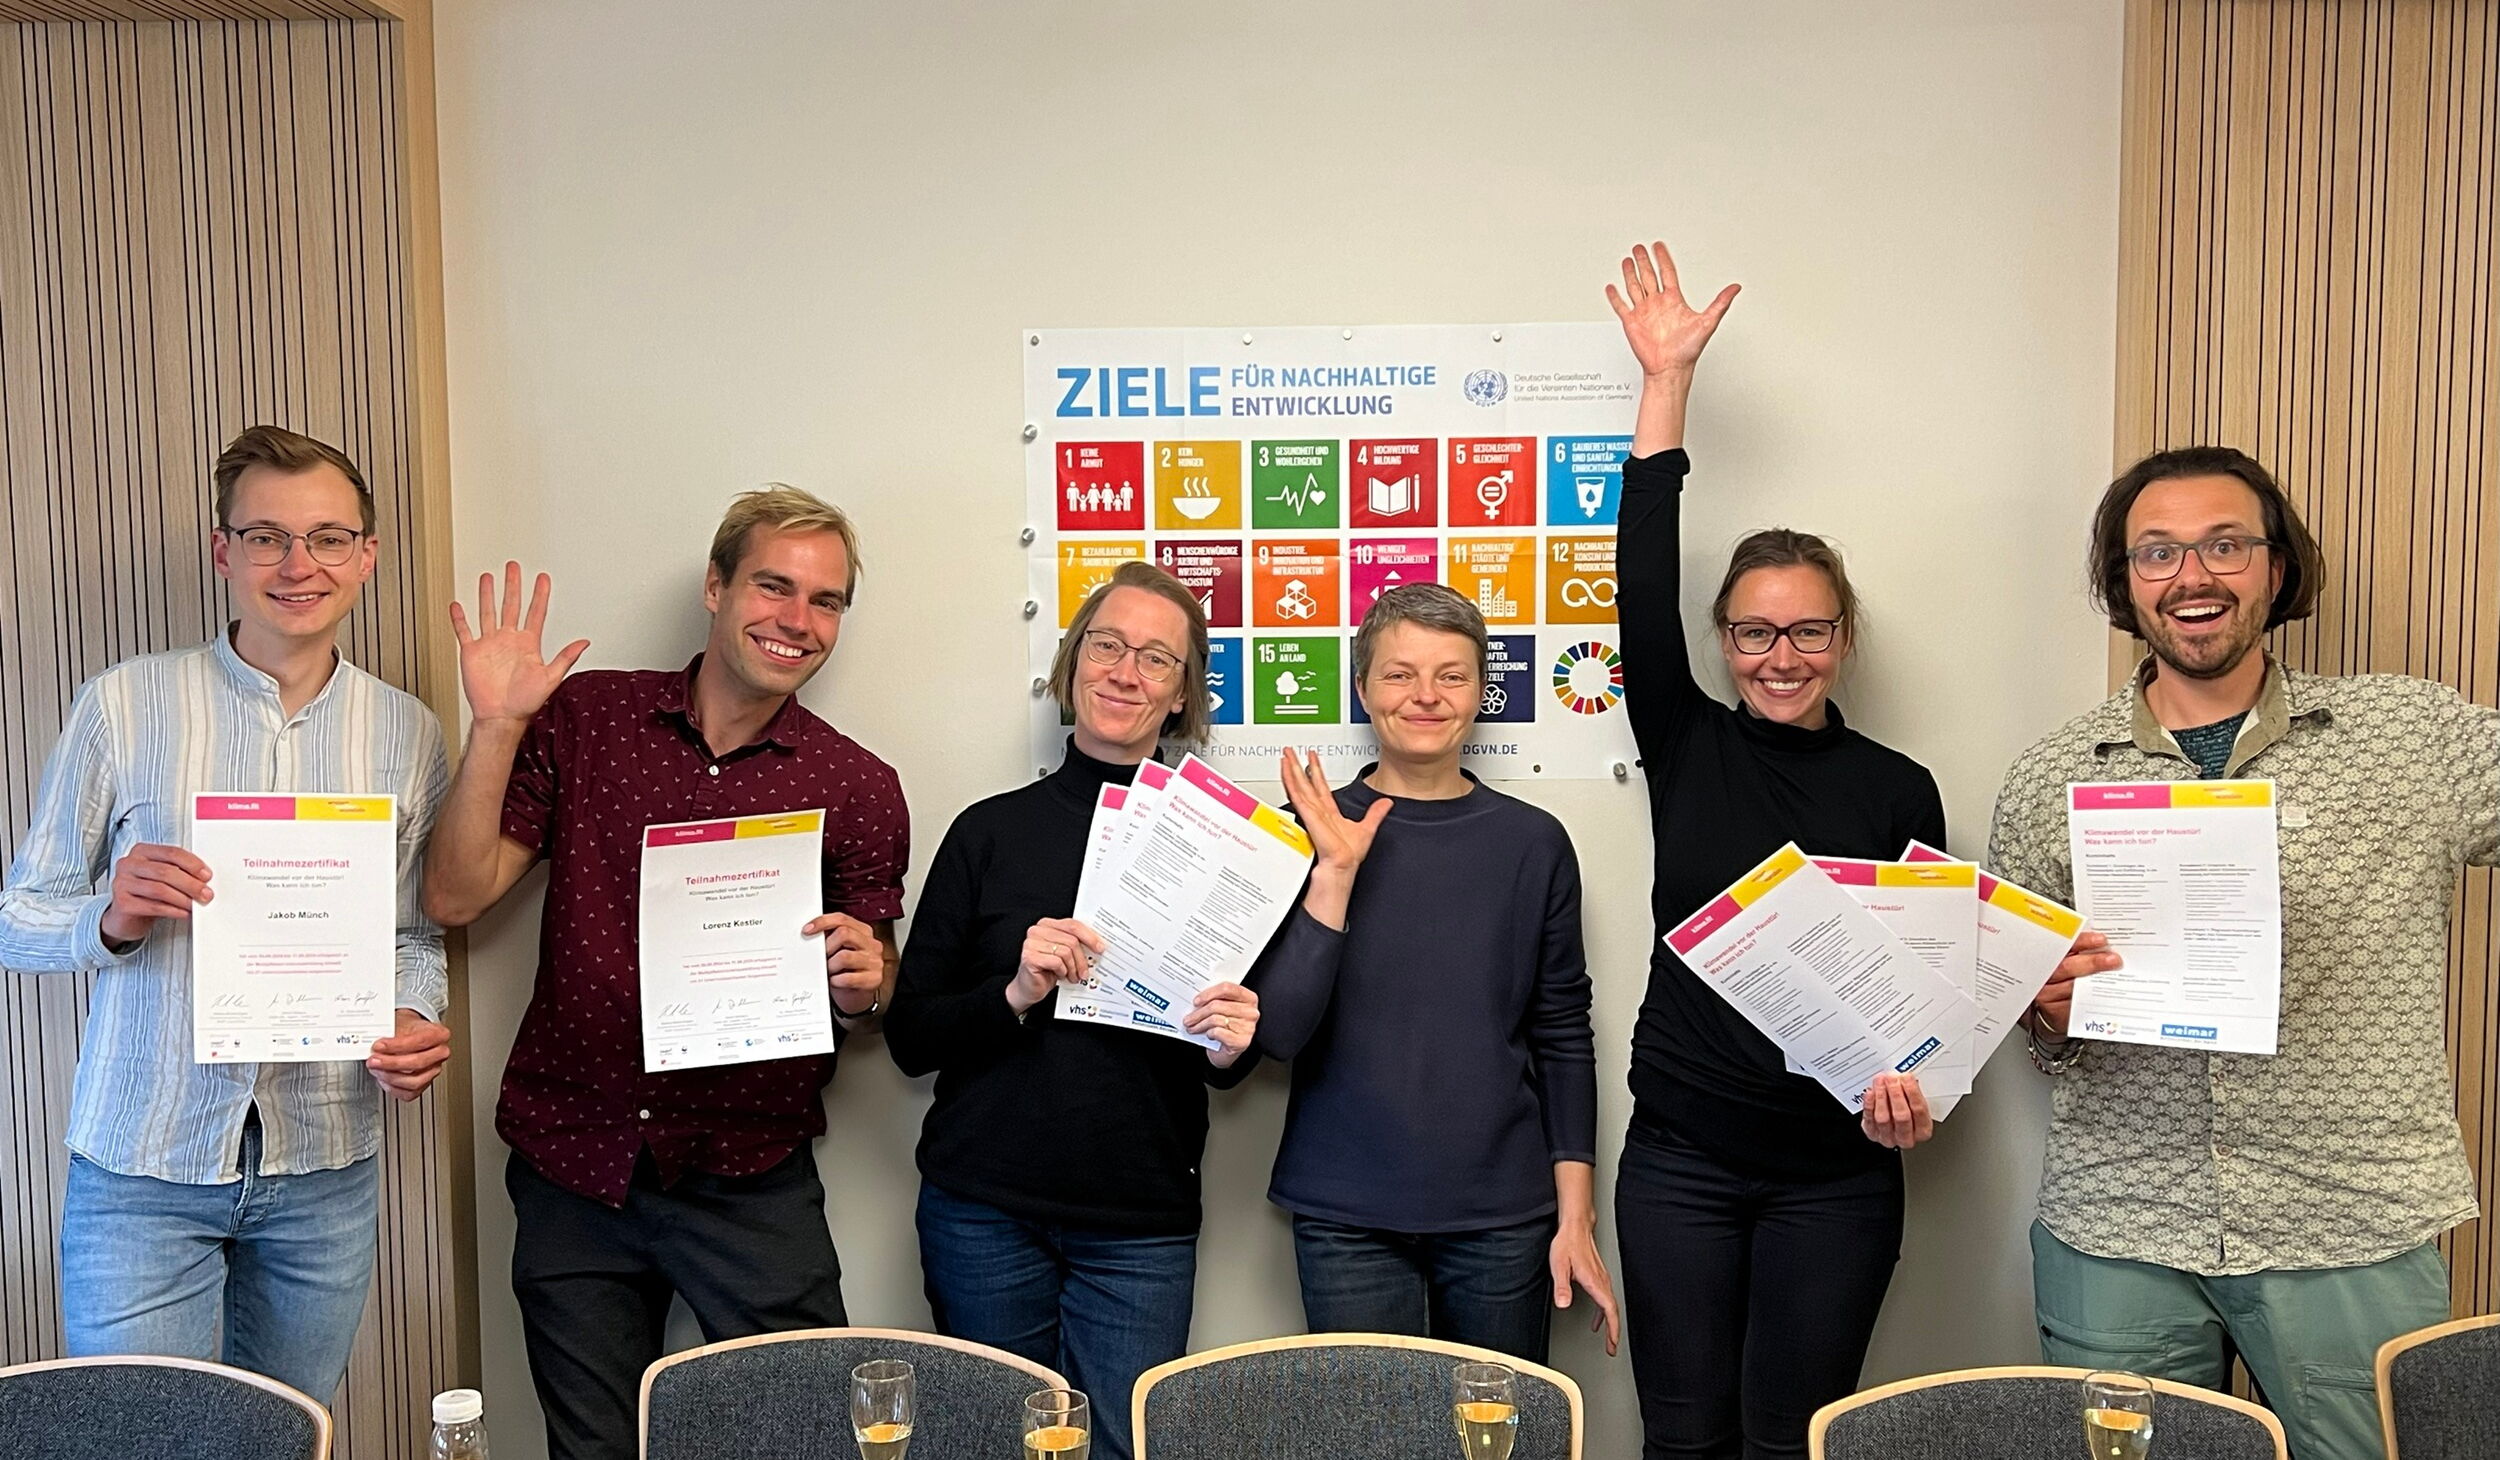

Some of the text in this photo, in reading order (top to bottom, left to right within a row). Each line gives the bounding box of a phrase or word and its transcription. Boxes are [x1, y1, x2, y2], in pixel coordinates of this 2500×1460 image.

[1232, 364, 1437, 387] FÜR NACHHALTIGE
[1514, 373, 1602, 382] Deutsche Gesellschaft
[1056, 367, 1221, 417] ZIELE
[1514, 384, 1526, 392] für
[1527, 384, 1539, 392] die
[1541, 384, 1578, 392] Vereinten
[1579, 383, 1614, 392] Nationen
[1232, 395, 1393, 416] ENTWICKLUNG
[1178, 448, 1193, 456] KEIN
[1275, 446, 1329, 456] GESUNDHEIT UND
[1374, 445, 1420, 454] HOCHWERTIGE
[1473, 444, 1525, 453] GESCHLECHTER-
[1572, 442, 1606, 452] SAUBERES
[1080, 448, 1099, 457] KEINE
[1259, 447, 1269, 467] 3
[1357, 446, 1368, 465] 4
[1456, 444, 1466, 464] 5
[1555, 443, 1566, 463] 6
[1572, 453, 1586, 462] UND
[1065, 448, 1073, 468] 1
[1080, 458, 1103, 468] ARMUT
[1161, 448, 1171, 468] 2
[1178, 458, 1204, 467] HUNGER
[1275, 457, 1323, 466] WOHLERGEHEN
[1374, 456, 1402, 465] BILDUNG
[1473, 454, 1509, 464] GLEICHHEIT
[1124, 547, 1137, 556] UND
[1377, 544, 1406, 554] WENIGER
[1472, 542, 1514, 552] NACHHALTIGE
[1066, 547, 1075, 567] 7
[1163, 547, 1173, 566] 8
[1259, 546, 1269, 565] 9
[1354, 545, 1373, 564] 10
[1453, 544, 1467, 564] 11
[1552, 543, 1569, 562] 12
[1377, 555, 1430, 564] UNGLEICHHEITEN
[1178, 567, 1223, 577] WIRTSCHAFTS-
[1272, 566, 1324, 576] INFRASTRUKTUR
[1279, 643, 1300, 652] LEBEN
[1258, 644, 1276, 663] 15
[1280, 654, 1306, 662] AN LAND
[1488, 662, 1528, 671] ERREICHUNG
[1488, 672, 1505, 682] ZIELE
[1211, 744, 1236, 756] FÜR
[243, 858, 350, 868] Teilnahmezertifikat
[685, 869, 780, 886] Teilnahmezertifikat
[268, 911, 330, 920] Jakob Münch
[703, 921, 732, 930] Lorenz
[1129, 982, 1168, 1008] weimar
[1069, 1004, 1087, 1015] vhs
[2085, 1021, 2105, 1032] vhs
[2164, 1026, 2215, 1038] weimar
[336, 1034, 351, 1044] vhs
[778, 1034, 792, 1043] vhs
[1900, 1039, 1937, 1072] weimar
